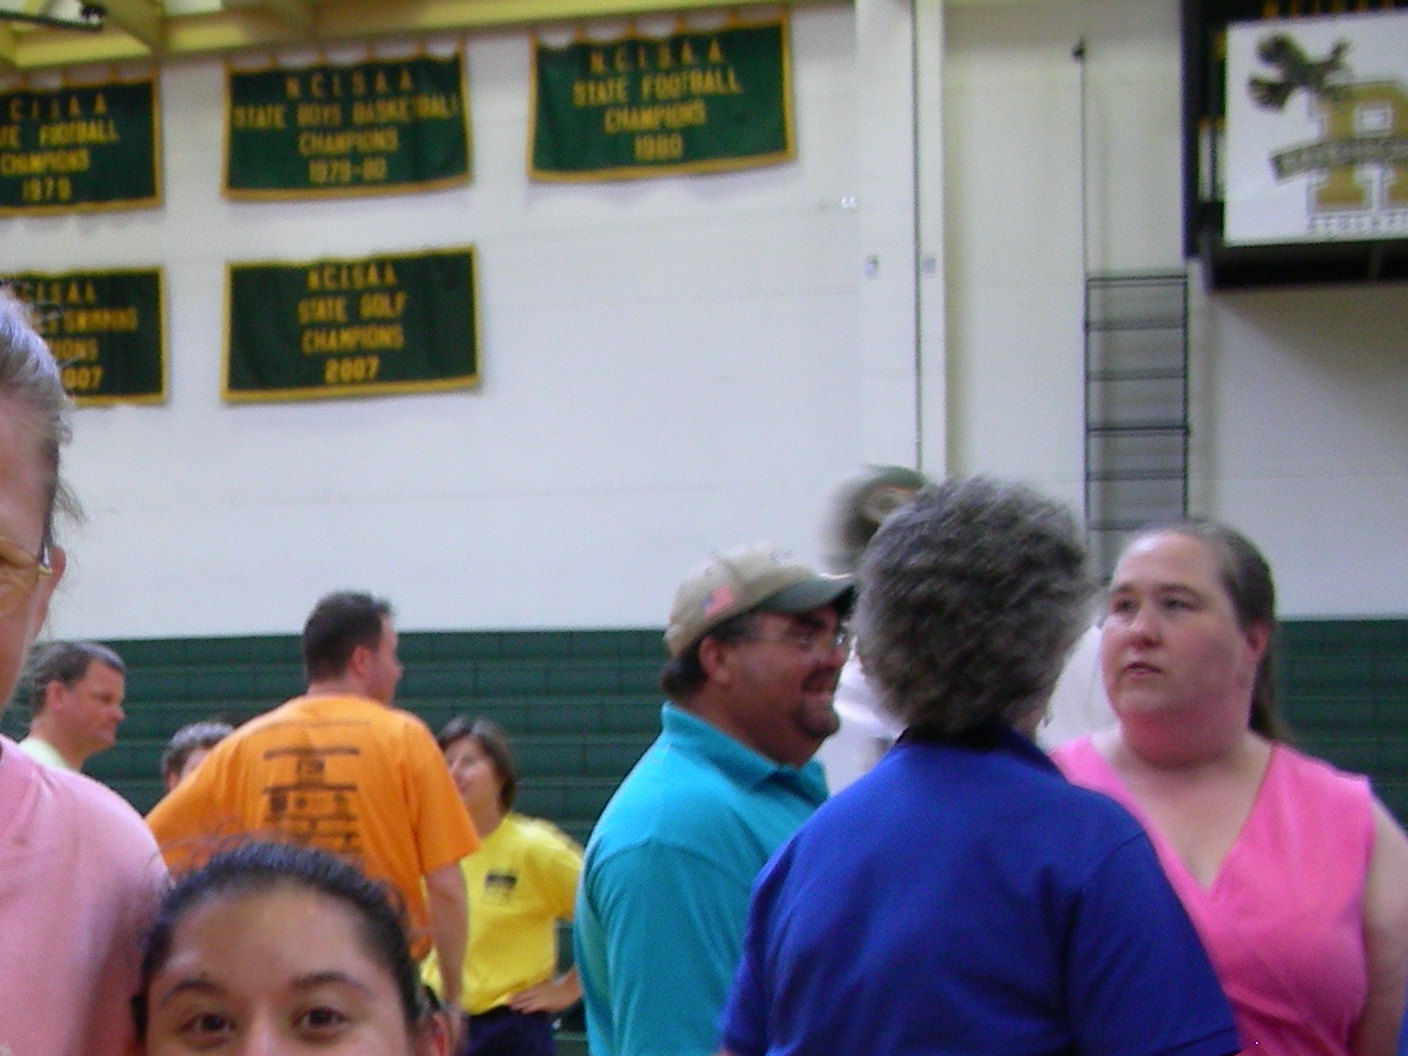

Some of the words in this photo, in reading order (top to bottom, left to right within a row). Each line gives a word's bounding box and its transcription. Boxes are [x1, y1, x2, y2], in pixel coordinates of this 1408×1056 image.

[573, 78, 628, 107] STATE
[641, 66, 743, 101] FOOTBALL
[233, 104, 286, 131] STATE
[352, 94, 459, 125] BASKETBALL
[604, 98, 705, 134] CHAMPIONS
[39, 119, 120, 145] FOOTBALL
[299, 128, 399, 156] CHAMPIONS
[0, 148, 90, 176] CHAMPIONS
[297, 297, 347, 325] STATE
[359, 291, 407, 319] GOLF
[301, 323, 404, 355] CHAMPIONS
[62, 366, 103, 390] 007
[324, 355, 380, 384] 2007
